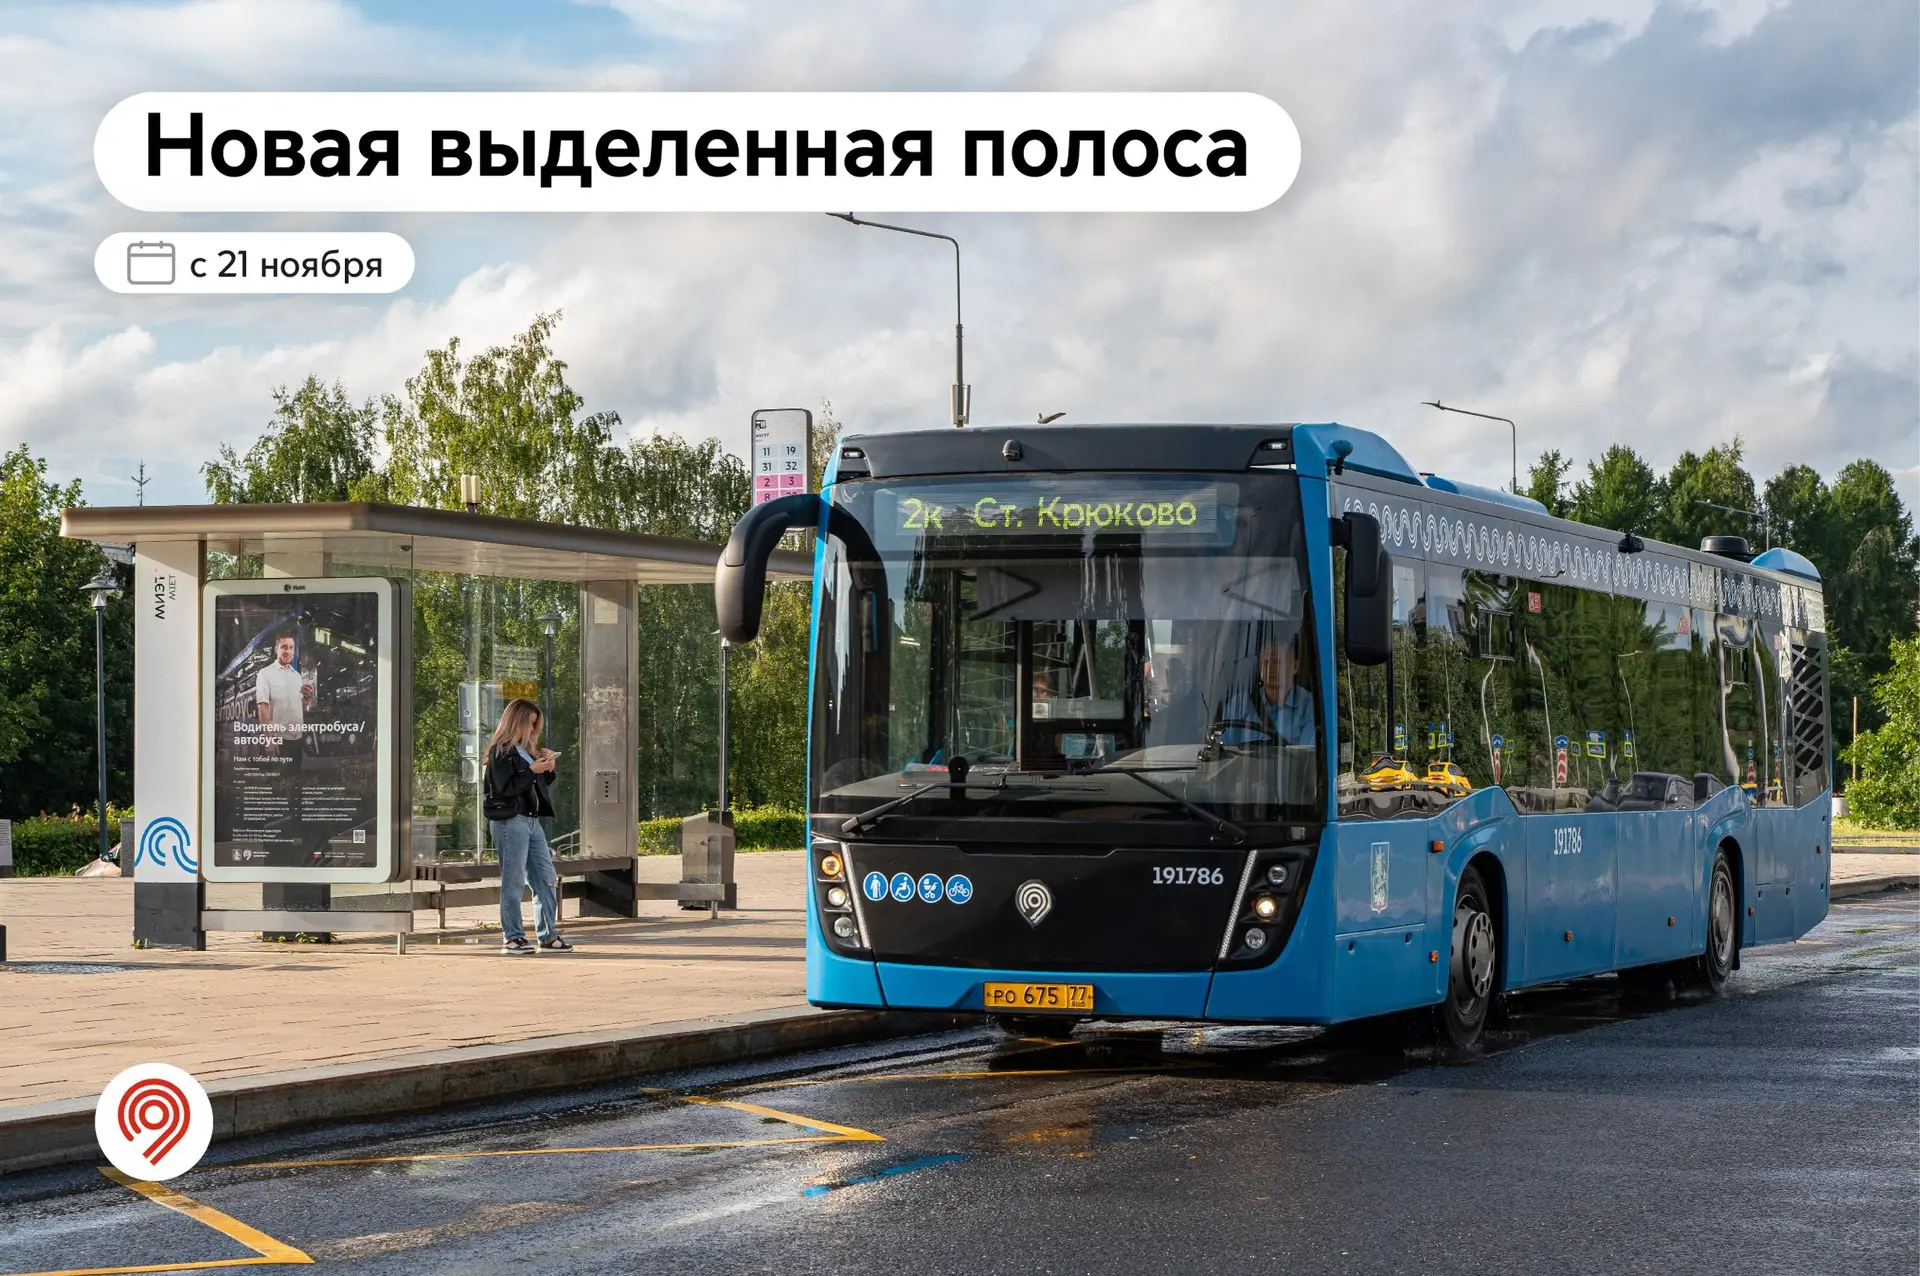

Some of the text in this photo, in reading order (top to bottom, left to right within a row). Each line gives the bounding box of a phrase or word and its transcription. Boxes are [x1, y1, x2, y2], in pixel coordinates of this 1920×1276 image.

[763, 446, 796, 456] 11 19
[762, 461, 797, 471] 31 32
[764, 476, 795, 487] 2 3
[973, 497, 1023, 528] Ст.
[1037, 496, 1197, 530] Крюково
[233, 721, 287, 734] Водитель
[233, 734, 283, 747] автобуса
[1554, 826, 1582, 855] 191786
[1153, 866, 1224, 885] 191786
[1023, 985, 1059, 1005] 675
[1068, 986, 1086, 1001] 77
